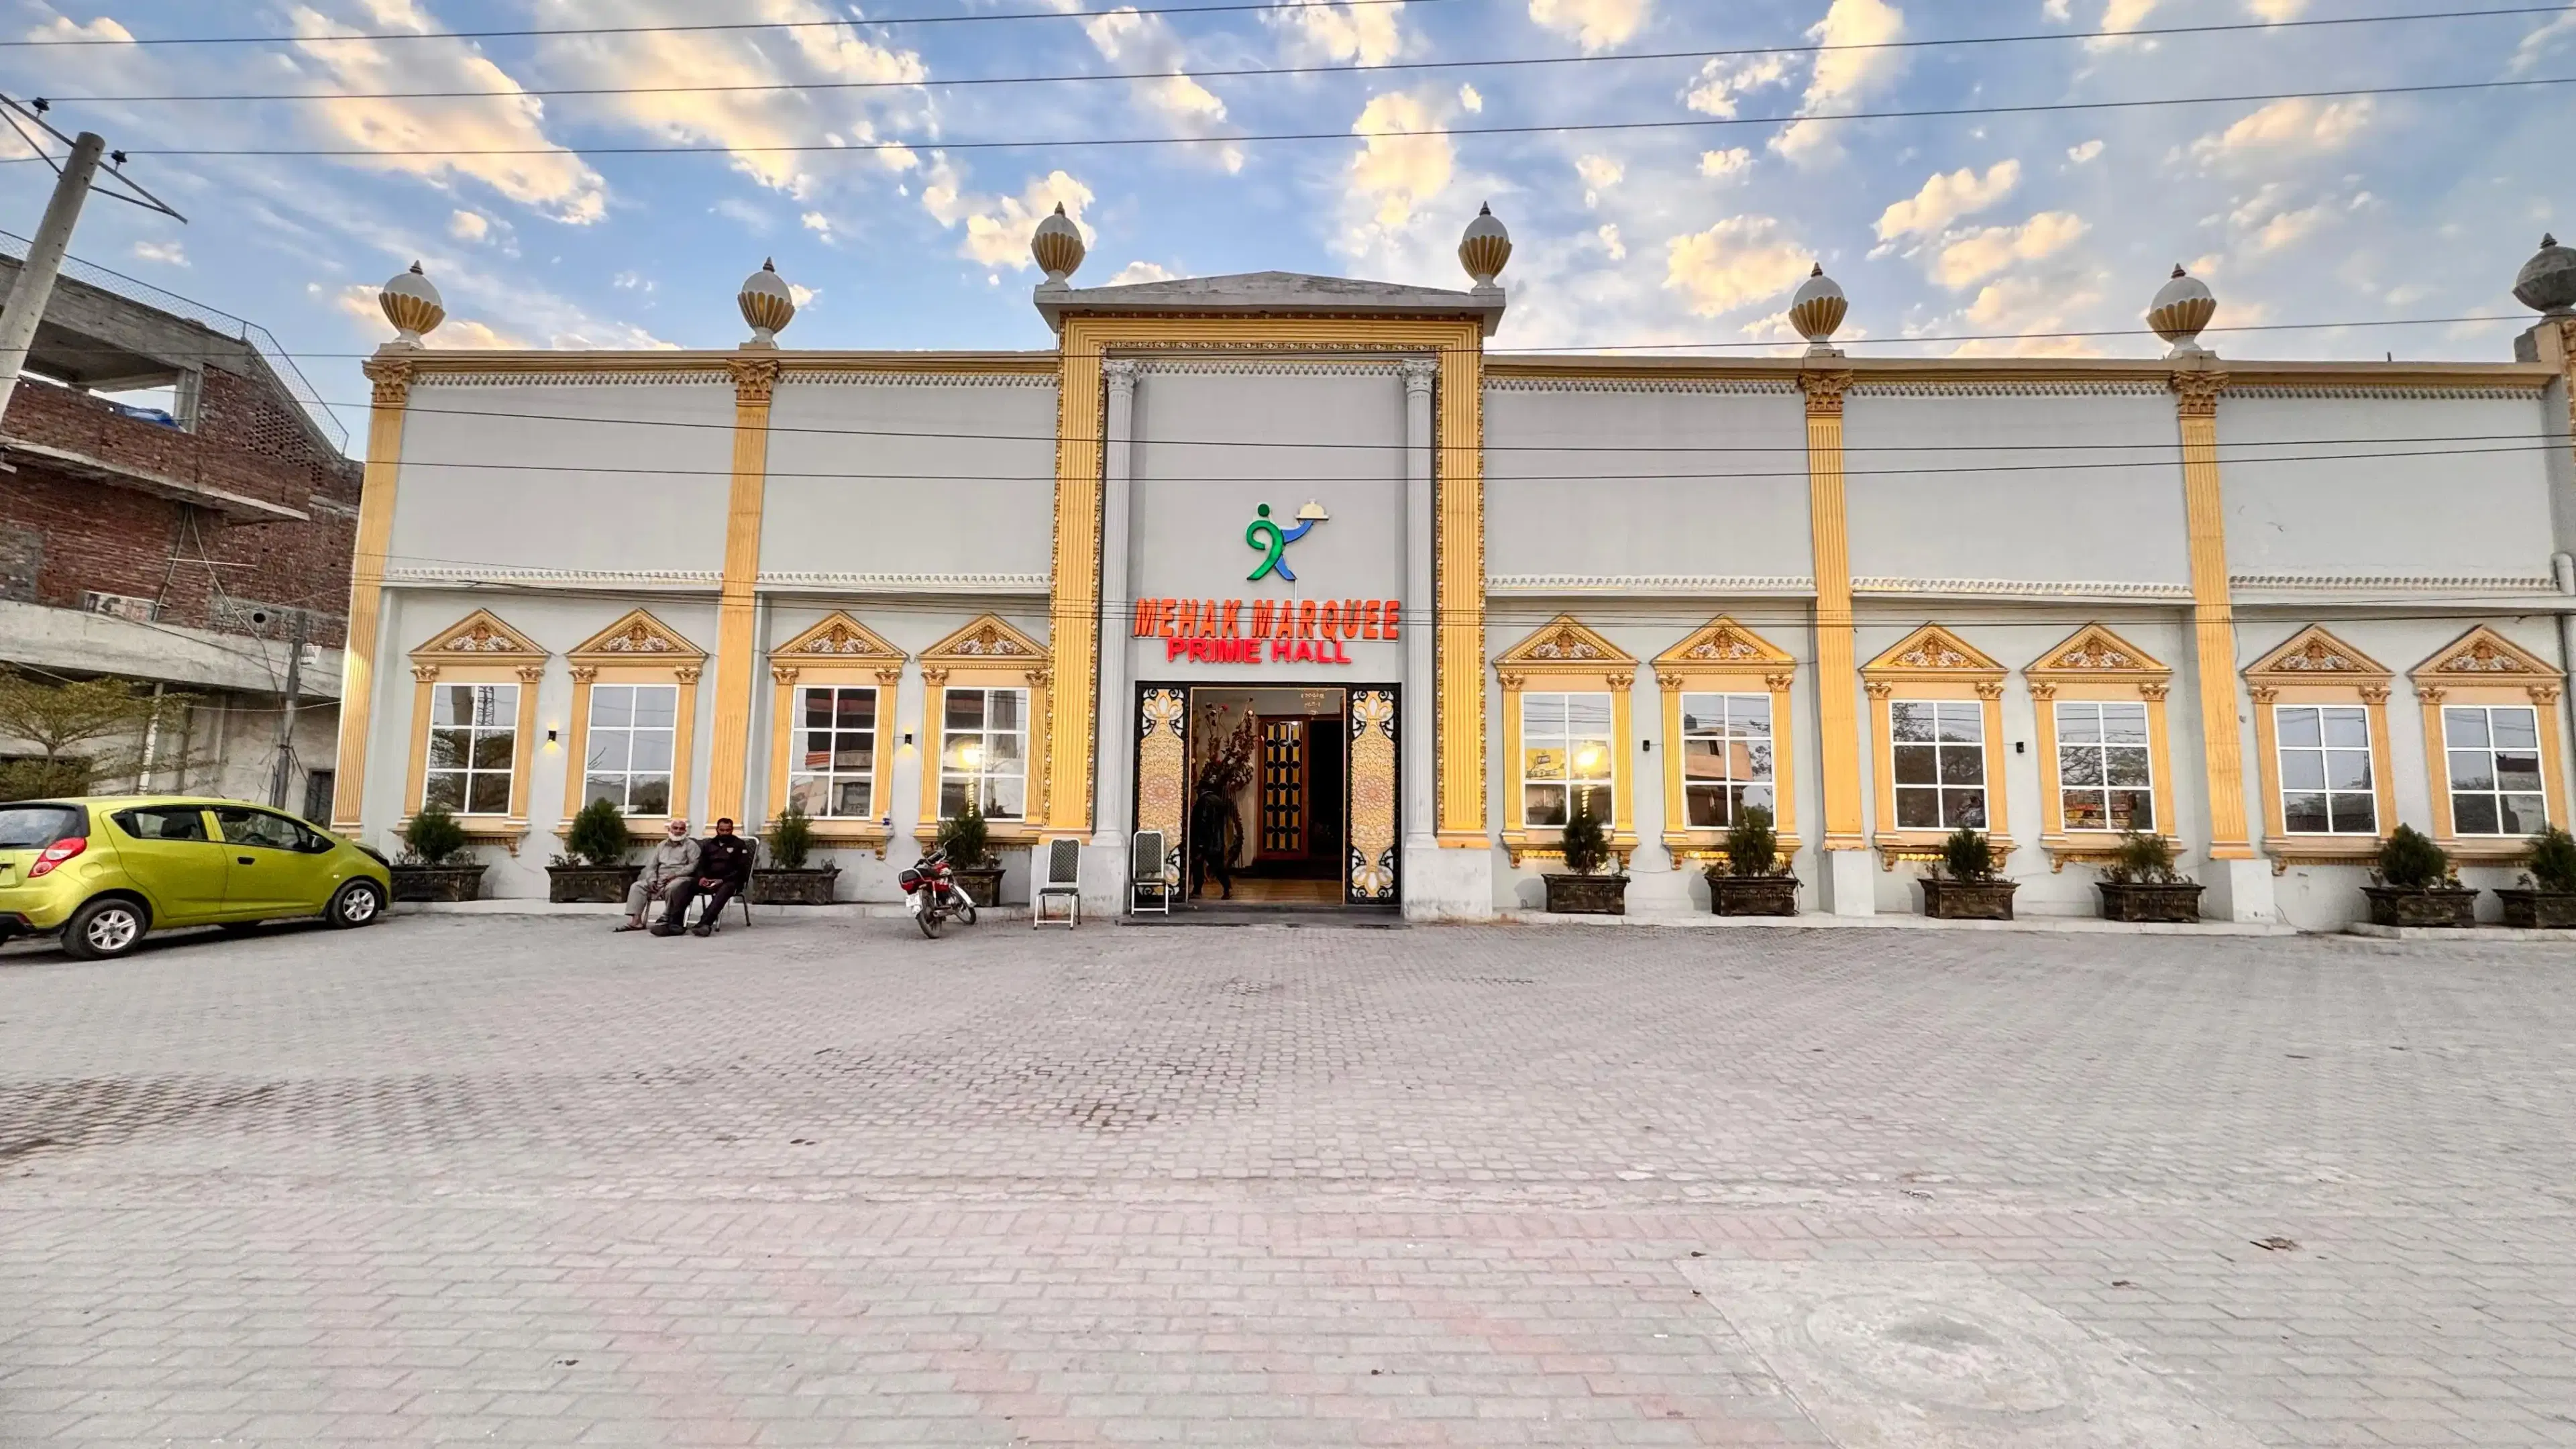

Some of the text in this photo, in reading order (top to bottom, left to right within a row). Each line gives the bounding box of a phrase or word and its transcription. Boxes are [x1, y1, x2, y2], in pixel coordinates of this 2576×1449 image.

[1134, 598, 1401, 643] MEHAK MARQUEE
[1166, 638, 1352, 664] PRIME HALL
